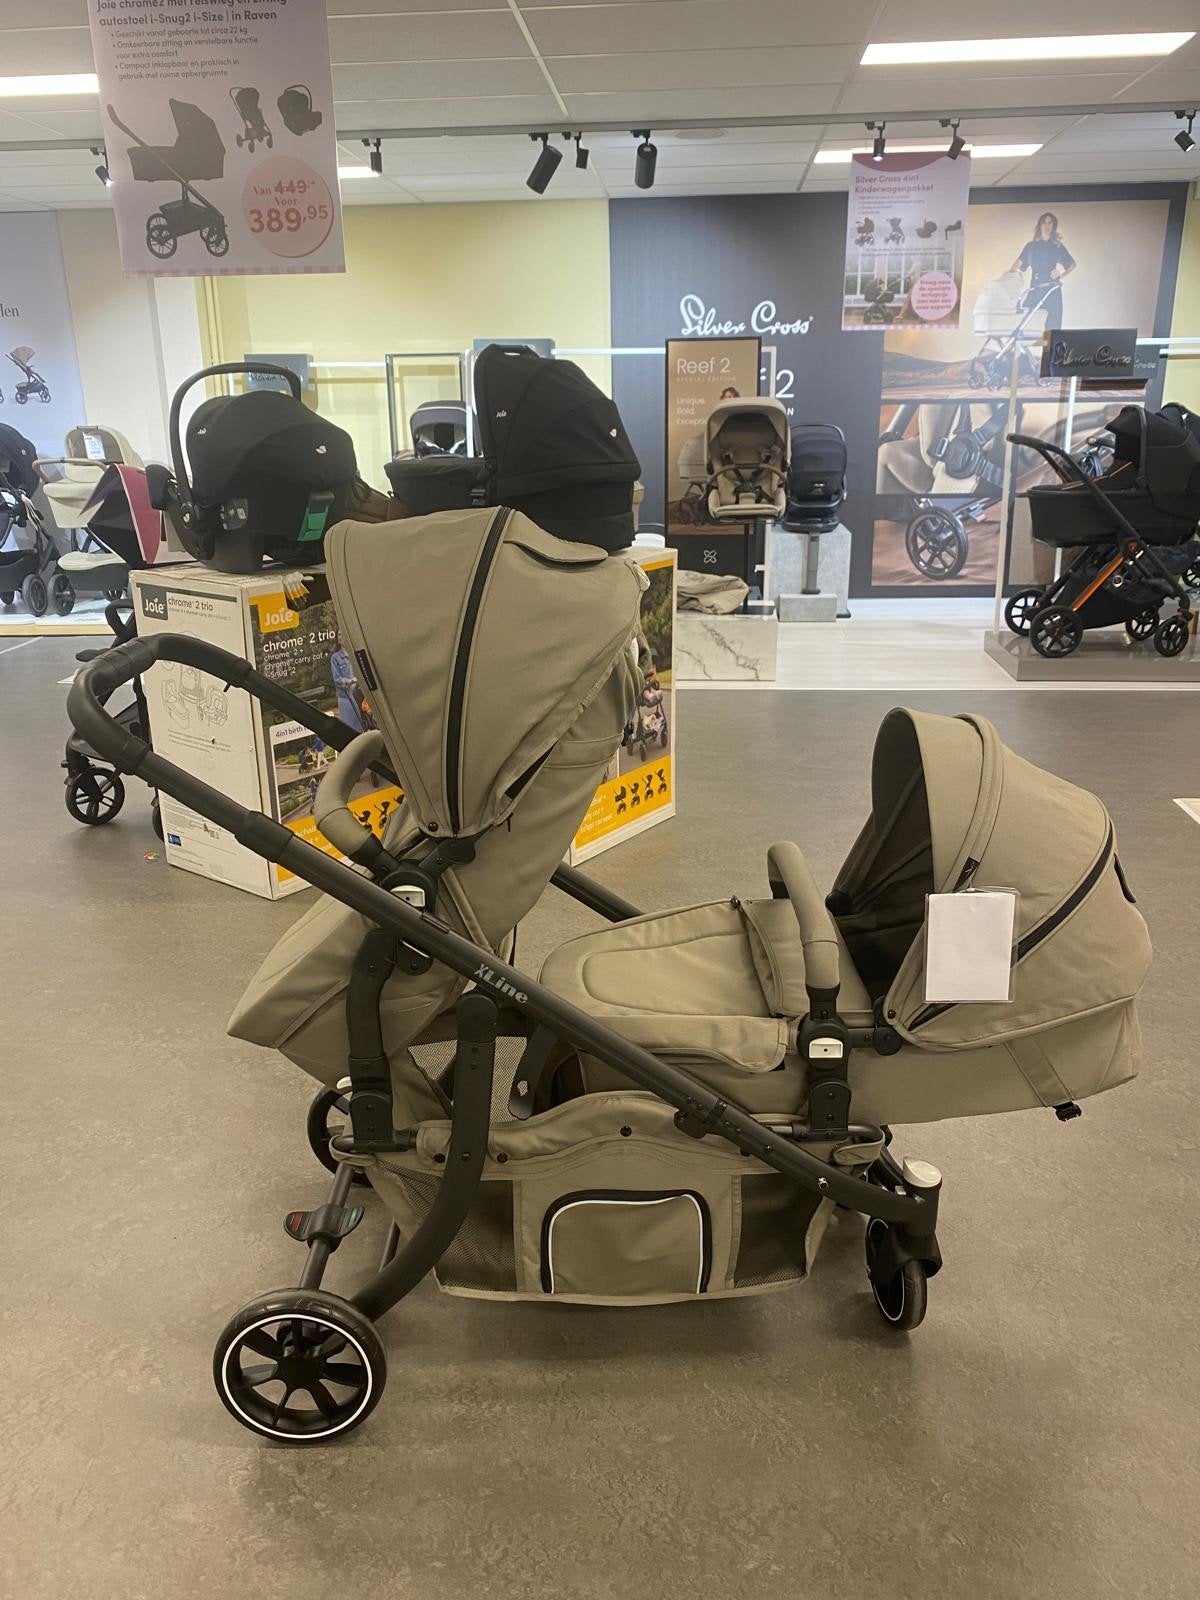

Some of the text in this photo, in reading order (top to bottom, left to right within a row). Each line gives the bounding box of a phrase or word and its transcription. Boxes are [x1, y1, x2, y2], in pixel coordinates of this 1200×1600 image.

[99, 14, 148, 26] autostoel
[150, 13, 191, 25] i-Snug2
[193, 11, 224, 23] i-Size
[231, 10, 242, 20] in
[244, 10, 277, 20] Raven
[151, 49, 178, 58] comfort
[855, 175, 878, 184] Silver
[879, 174, 901, 183] Cross
[252, 186, 272, 195] Van
[855, 184, 934, 194] Kinderwagenpakket
[274, 196, 298, 206] Voor
[249, 204, 329, 233] 389,95
[679, 294, 810, 336] Silver Cross
[676, 356, 731, 374] Reef 2
[775, 369, 795, 399] 2
[144, 597, 165, 614] Joie
[195, 600, 201, 610] 2
[201, 602, 214, 612] trio
[264, 607, 294, 627] Joie
[309, 632, 316, 644] 2
[317, 629, 336, 642] trio
[294, 656, 311, 664] carry
[275, 729, 288, 737] 4in1
[473, 963, 528, 1004] XLine
